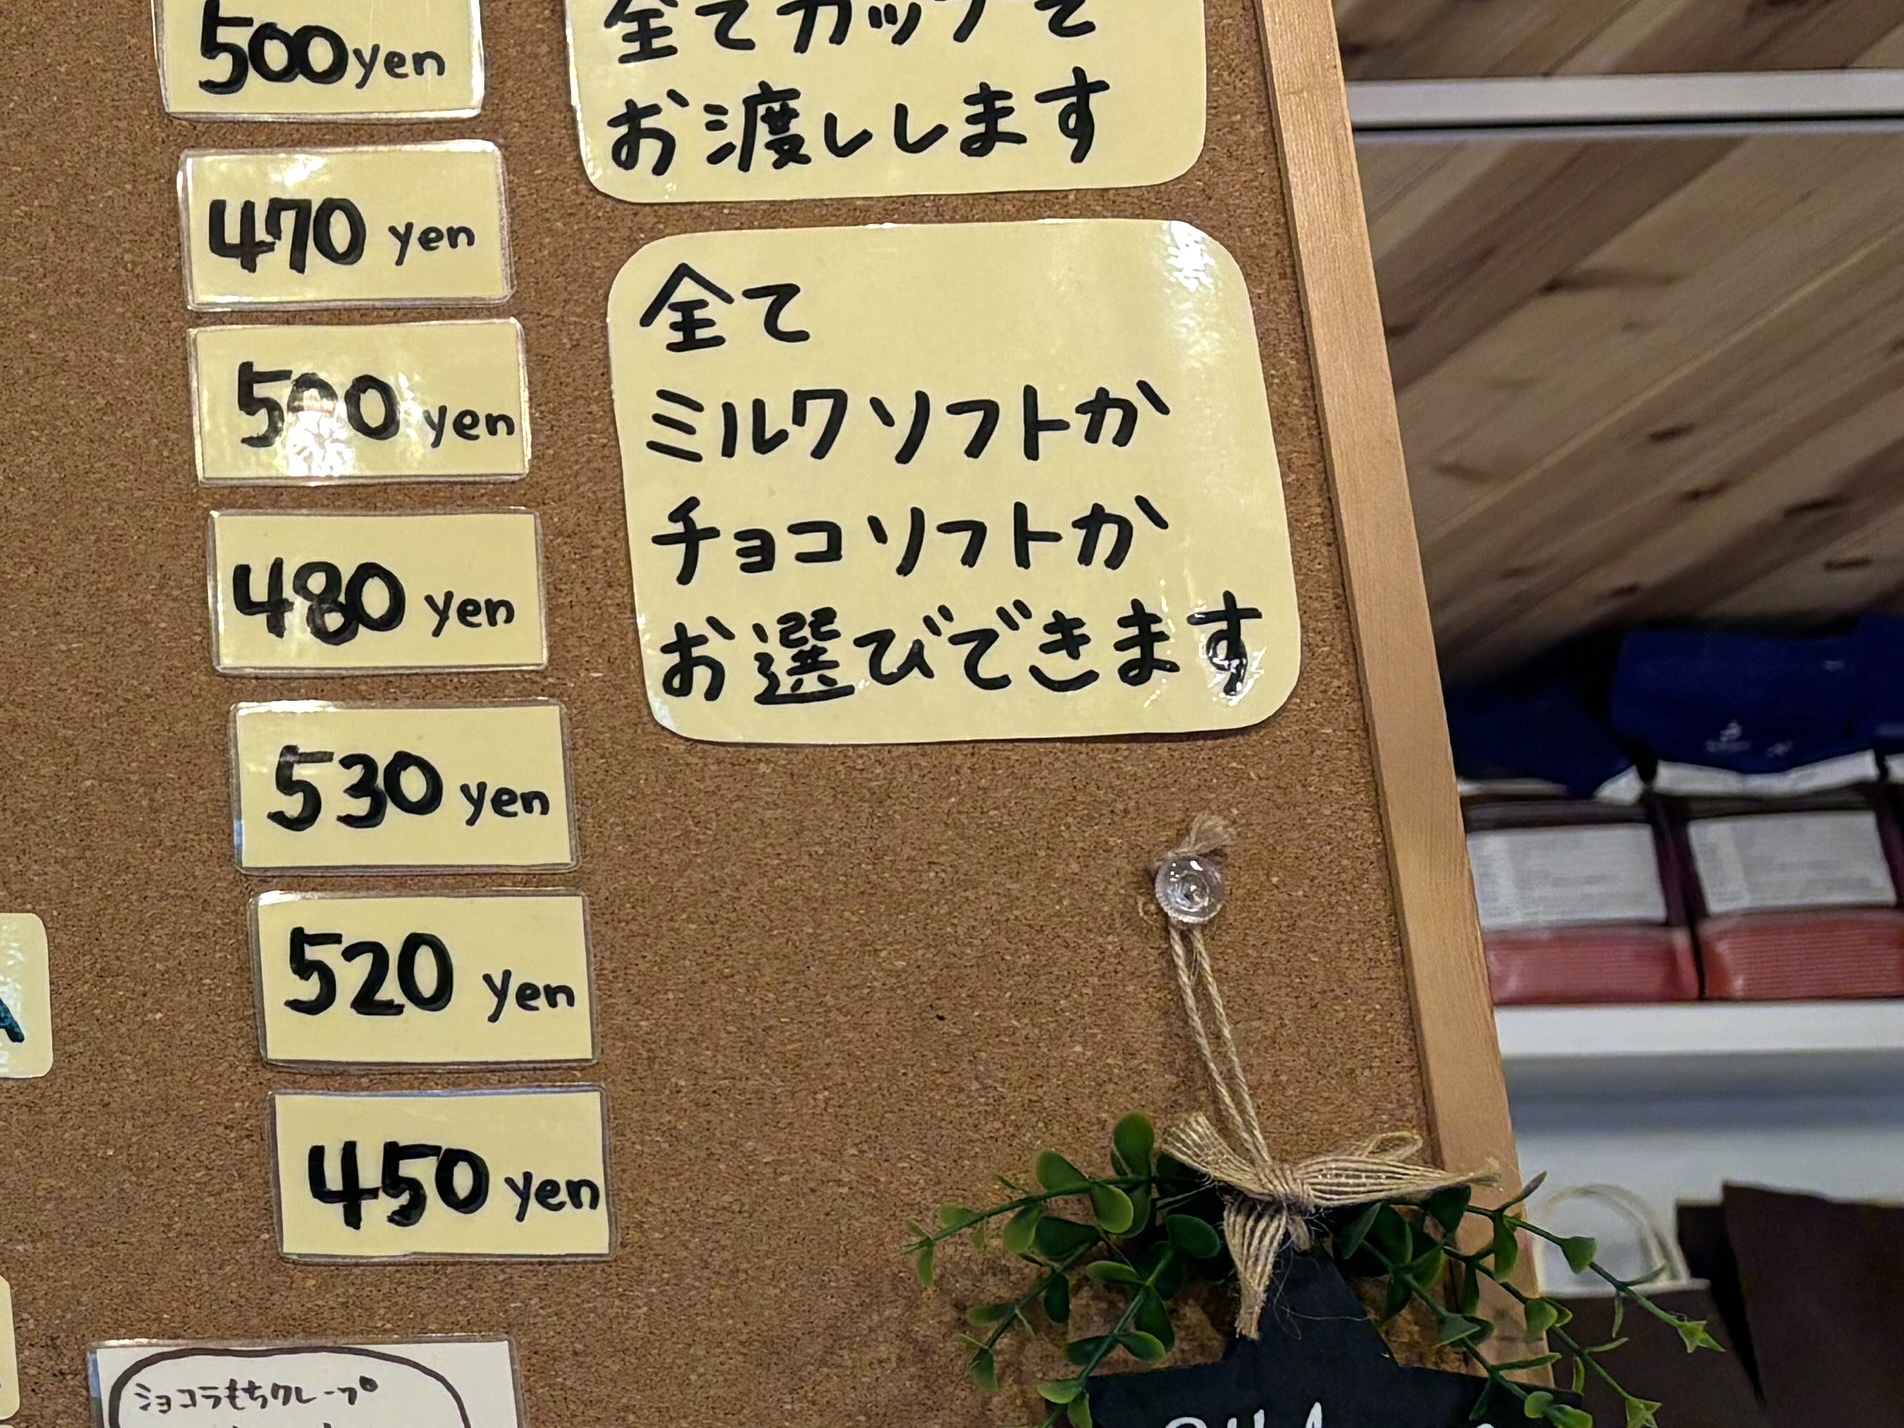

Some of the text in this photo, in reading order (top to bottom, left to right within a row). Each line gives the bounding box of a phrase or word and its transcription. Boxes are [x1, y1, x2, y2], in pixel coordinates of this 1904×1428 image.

[606, 66, 1111, 177] お渡しします
[639, 262, 811, 353] 全て
[645, 379, 1171, 465] ミルクソフトか
[651, 494, 1169, 586] チョコソフトか
[659, 590, 1263, 706] お選びできます
[134, 1376, 379, 1413] ショコラもちクレープ
